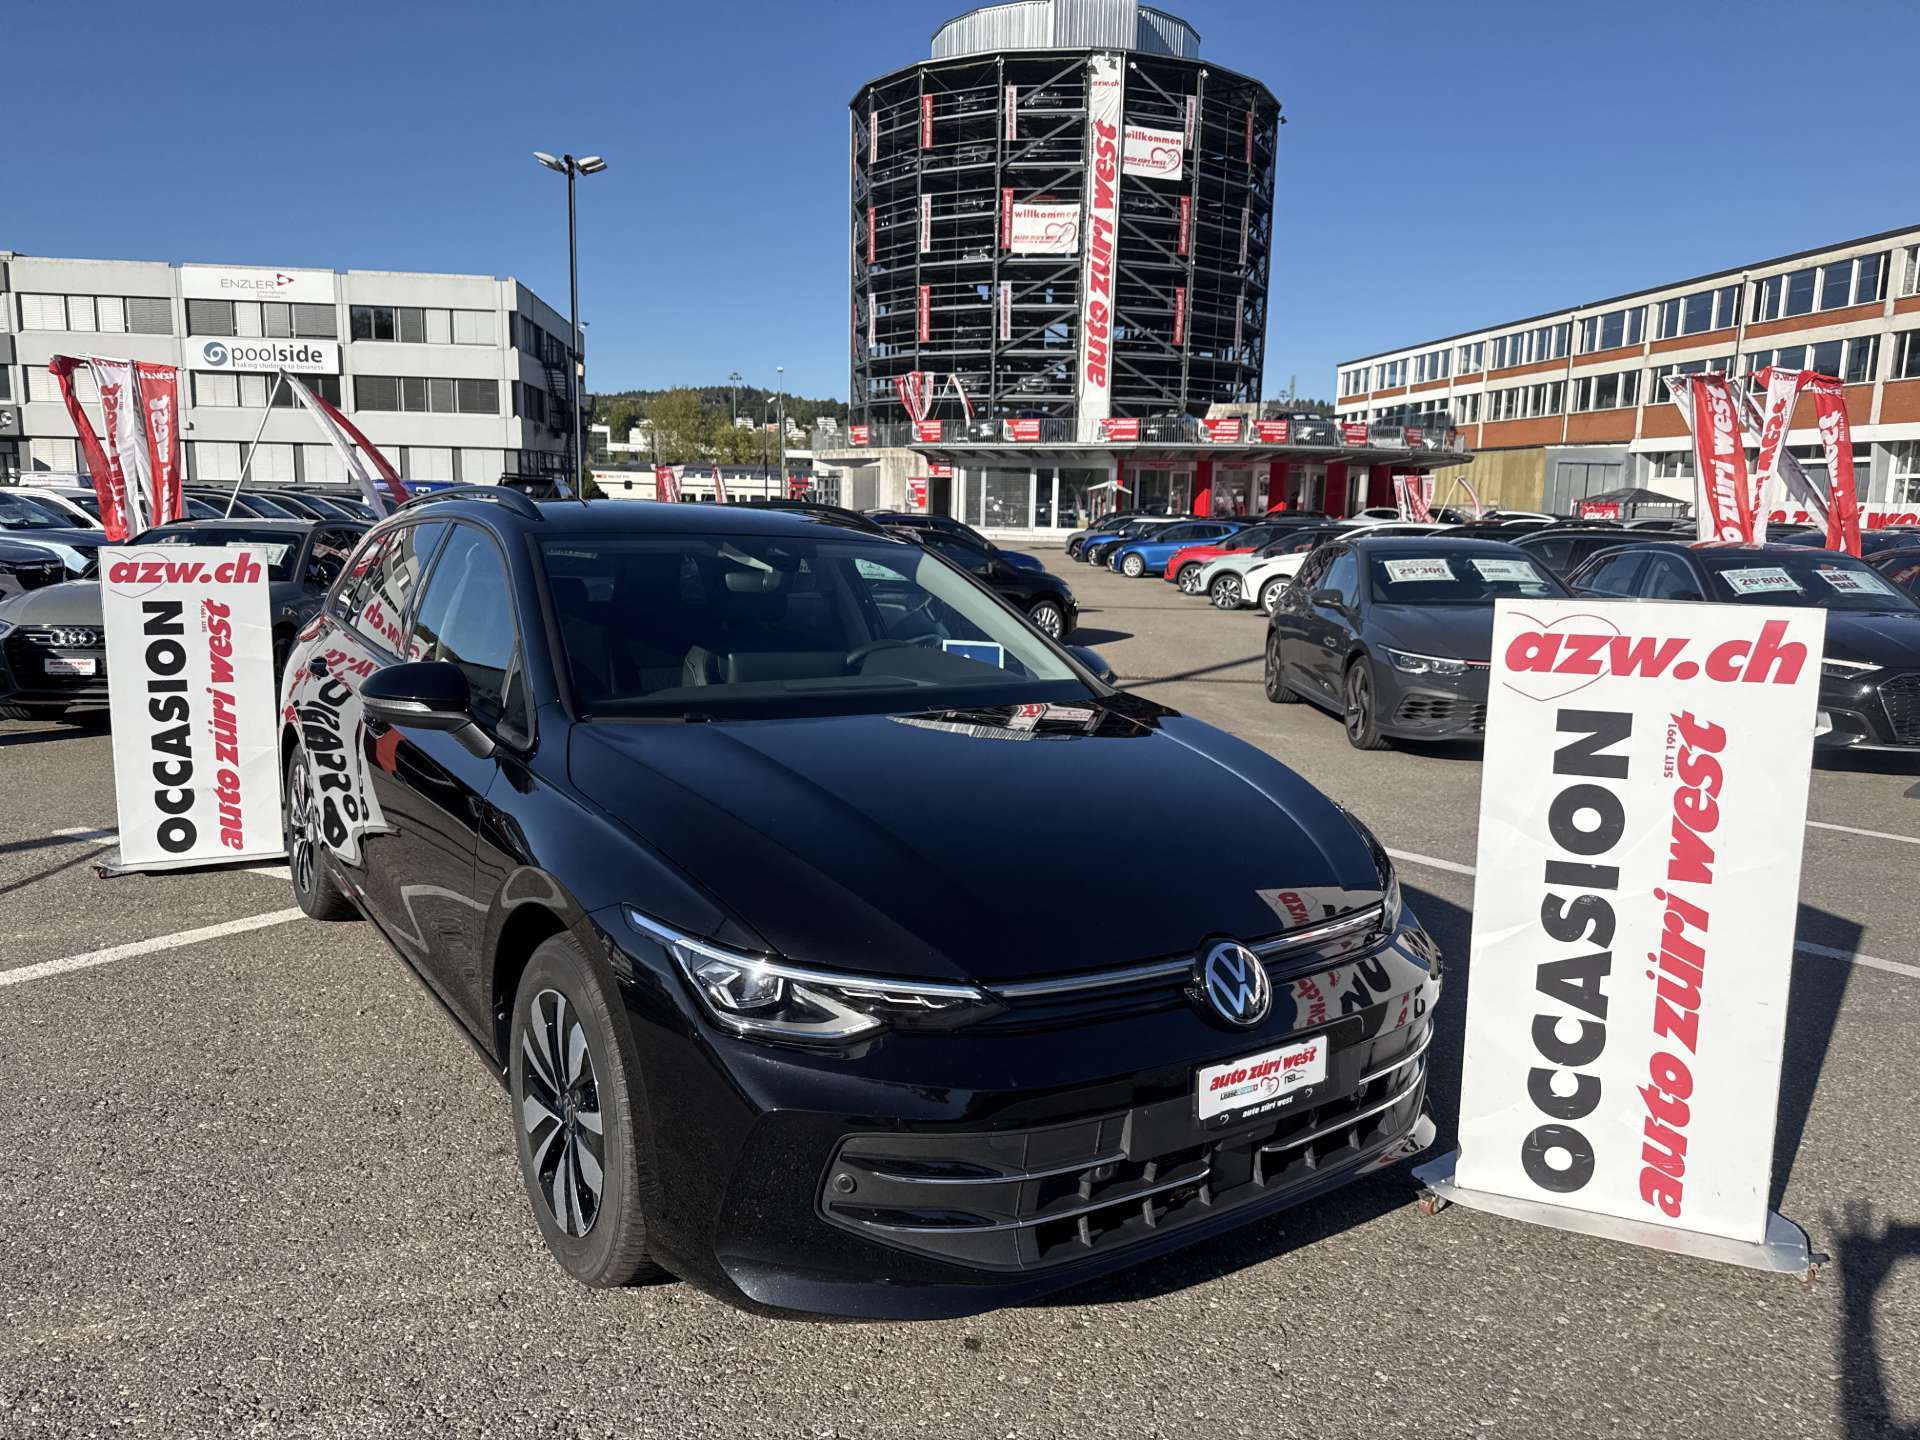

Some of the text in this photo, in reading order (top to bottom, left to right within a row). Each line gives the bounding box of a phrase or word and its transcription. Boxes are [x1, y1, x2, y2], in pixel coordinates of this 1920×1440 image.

[1124, 131, 1182, 145] willkommen
[1014, 209, 1078, 218] willkommen
[1087, 118, 1118, 388] auto züri west
[220, 278, 274, 290] ENZLER
[231, 343, 323, 367] poolside
[1705, 383, 1736, 456] west
[1710, 458, 1741, 525] züri
[109, 552, 261, 584] azw.ch
[1505, 620, 1808, 685] azw.ch
[142, 600, 198, 854] OCCASION
[201, 598, 244, 851] auto züri west
[1663, 723, 1678, 779] SEIT 1991
[1521, 708, 1633, 1193] OCCASION
[1637, 710, 1727, 1218] auto züri west
[1209, 1046, 1317, 1092] auto züri west
[1242, 1107, 1259, 1118] auto
[1277, 1095, 1294, 1107] west
